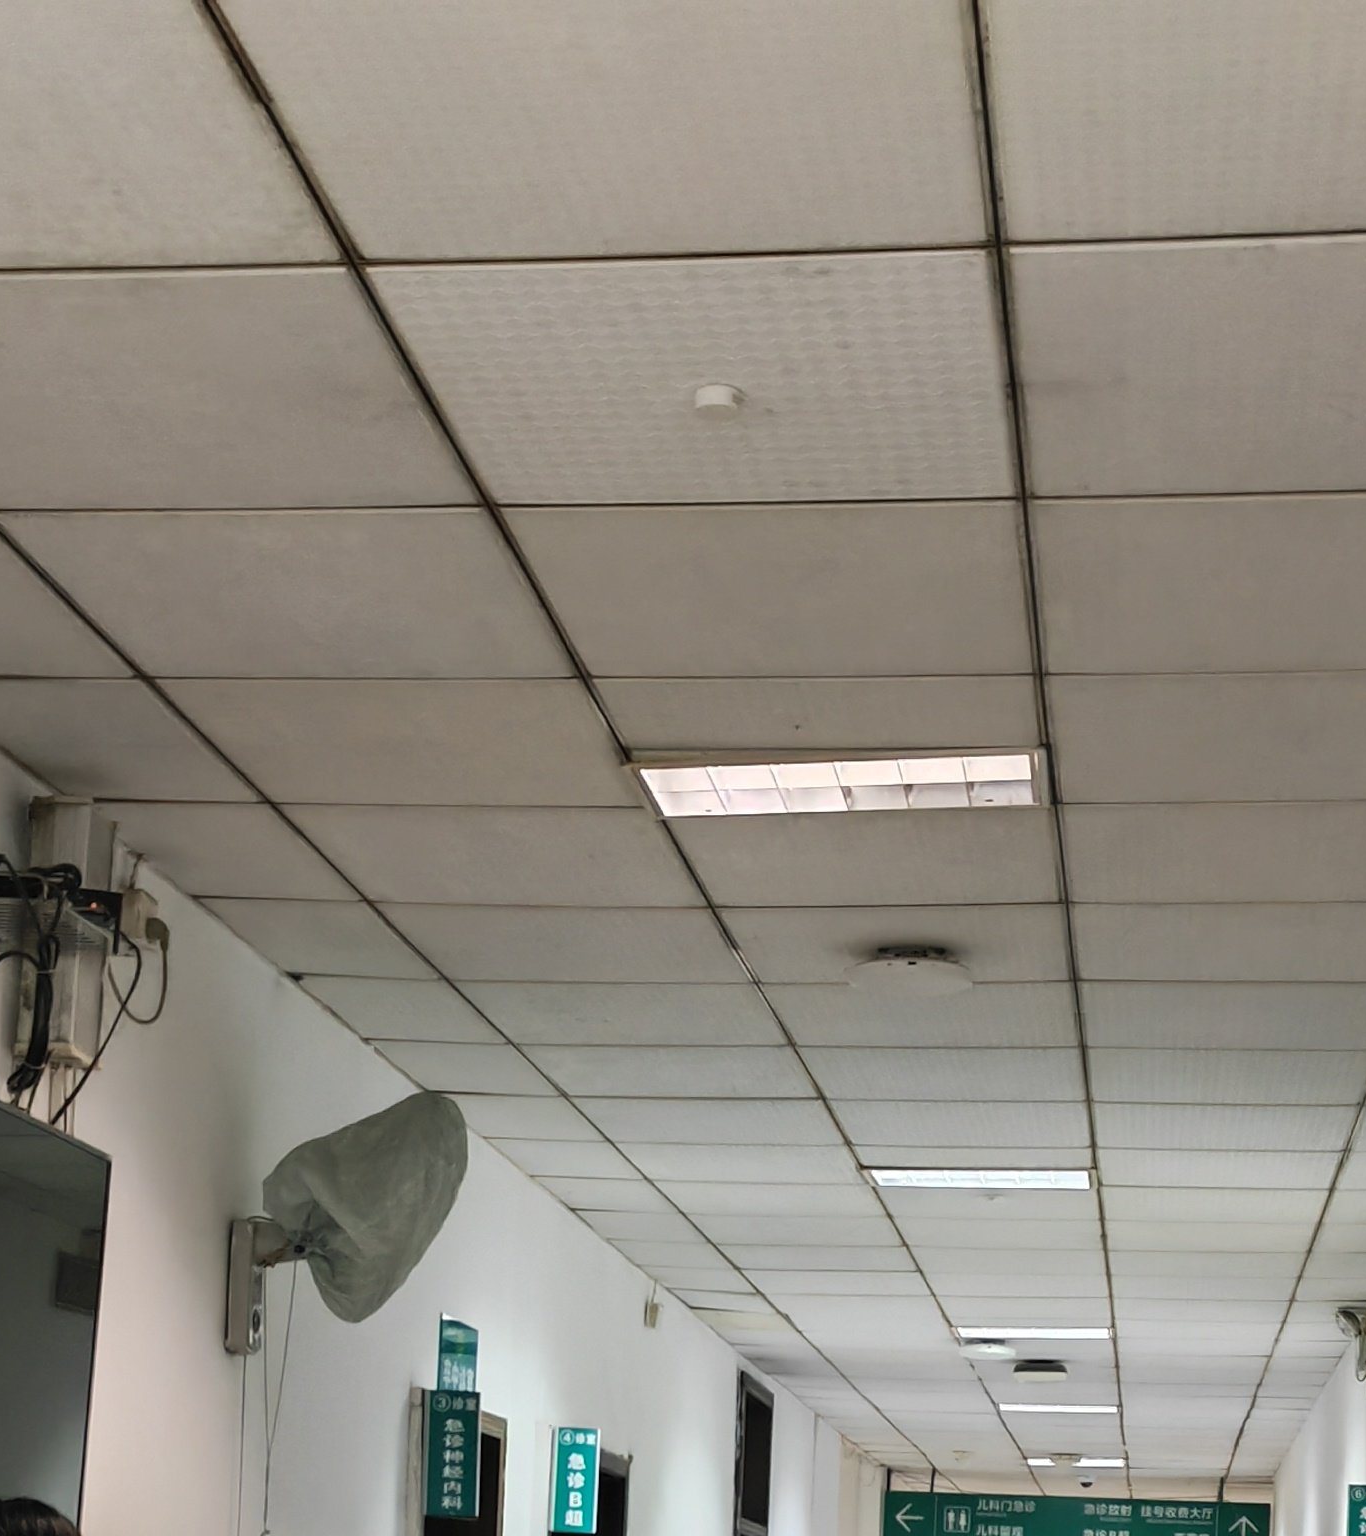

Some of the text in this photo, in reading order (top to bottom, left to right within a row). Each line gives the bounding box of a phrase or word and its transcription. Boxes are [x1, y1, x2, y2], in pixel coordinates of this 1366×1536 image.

[442, 1418, 464, 1511] 急诊神经内科
[977, 1499, 1036, 1513] 儿科门急诊
[1140, 1505, 1214, 1520] 挂号收费大厅
